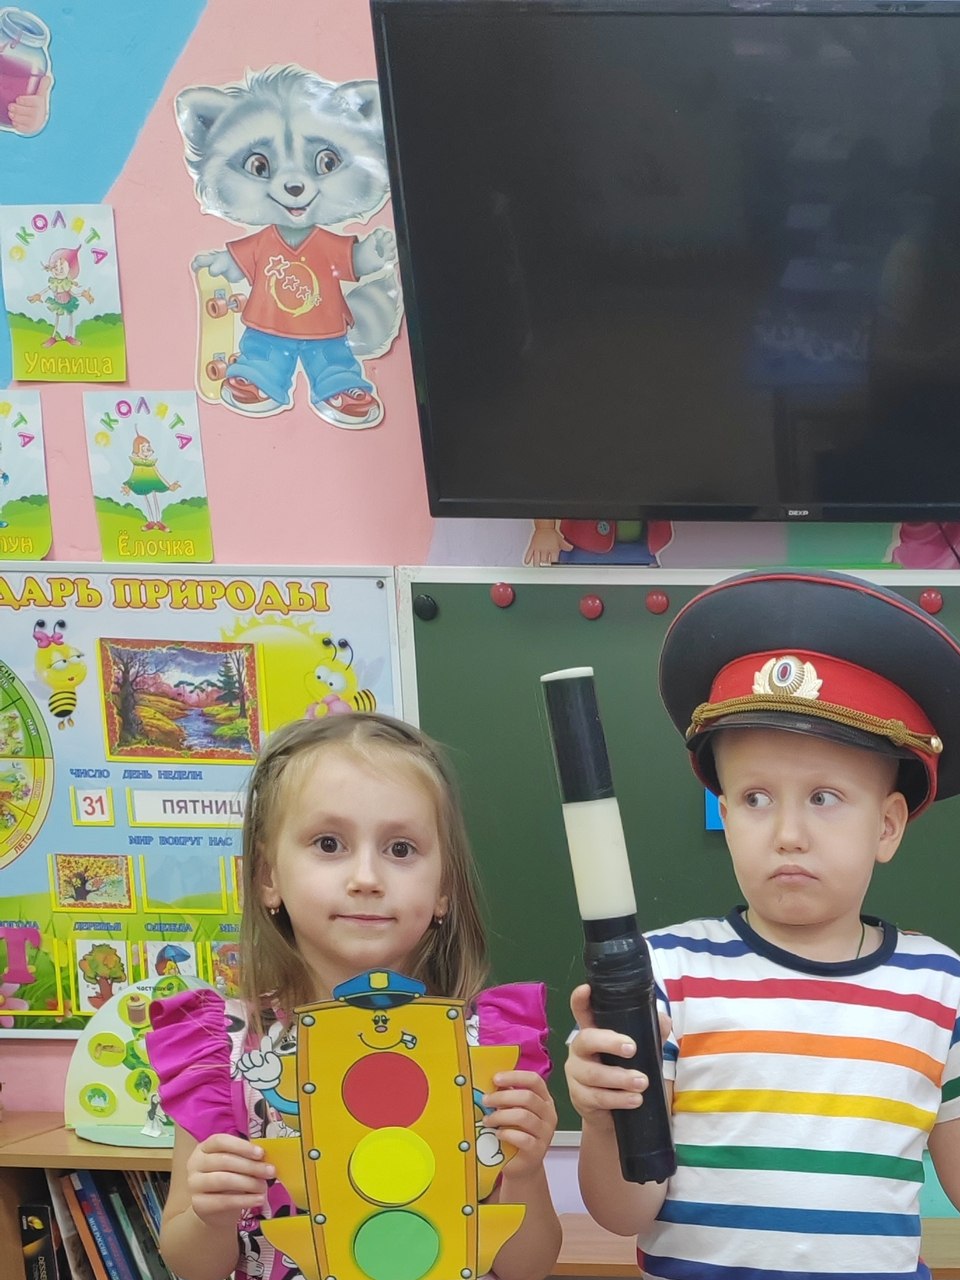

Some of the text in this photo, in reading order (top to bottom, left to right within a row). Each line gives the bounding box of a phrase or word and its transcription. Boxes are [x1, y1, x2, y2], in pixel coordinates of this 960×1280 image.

[24, 352, 114, 377] Умница
[117, 530, 196, 557] Ёлочка
[111, 577, 332, 616] ПРИРОДЫ
[69, 768, 111, 779] ЧИСЛО
[122, 769, 203, 781] ДЕНЬ НЕДЕЛИ
[82, 794, 106, 816] 31
[14, 832, 33, 855] ЛЕТО
[128, 835, 233, 847] МИР ВОКРУГ НАС
[73, 921, 122, 932] ДЕРЕВЬЯ
[144, 922, 193, 933] ОДЕЖДА
